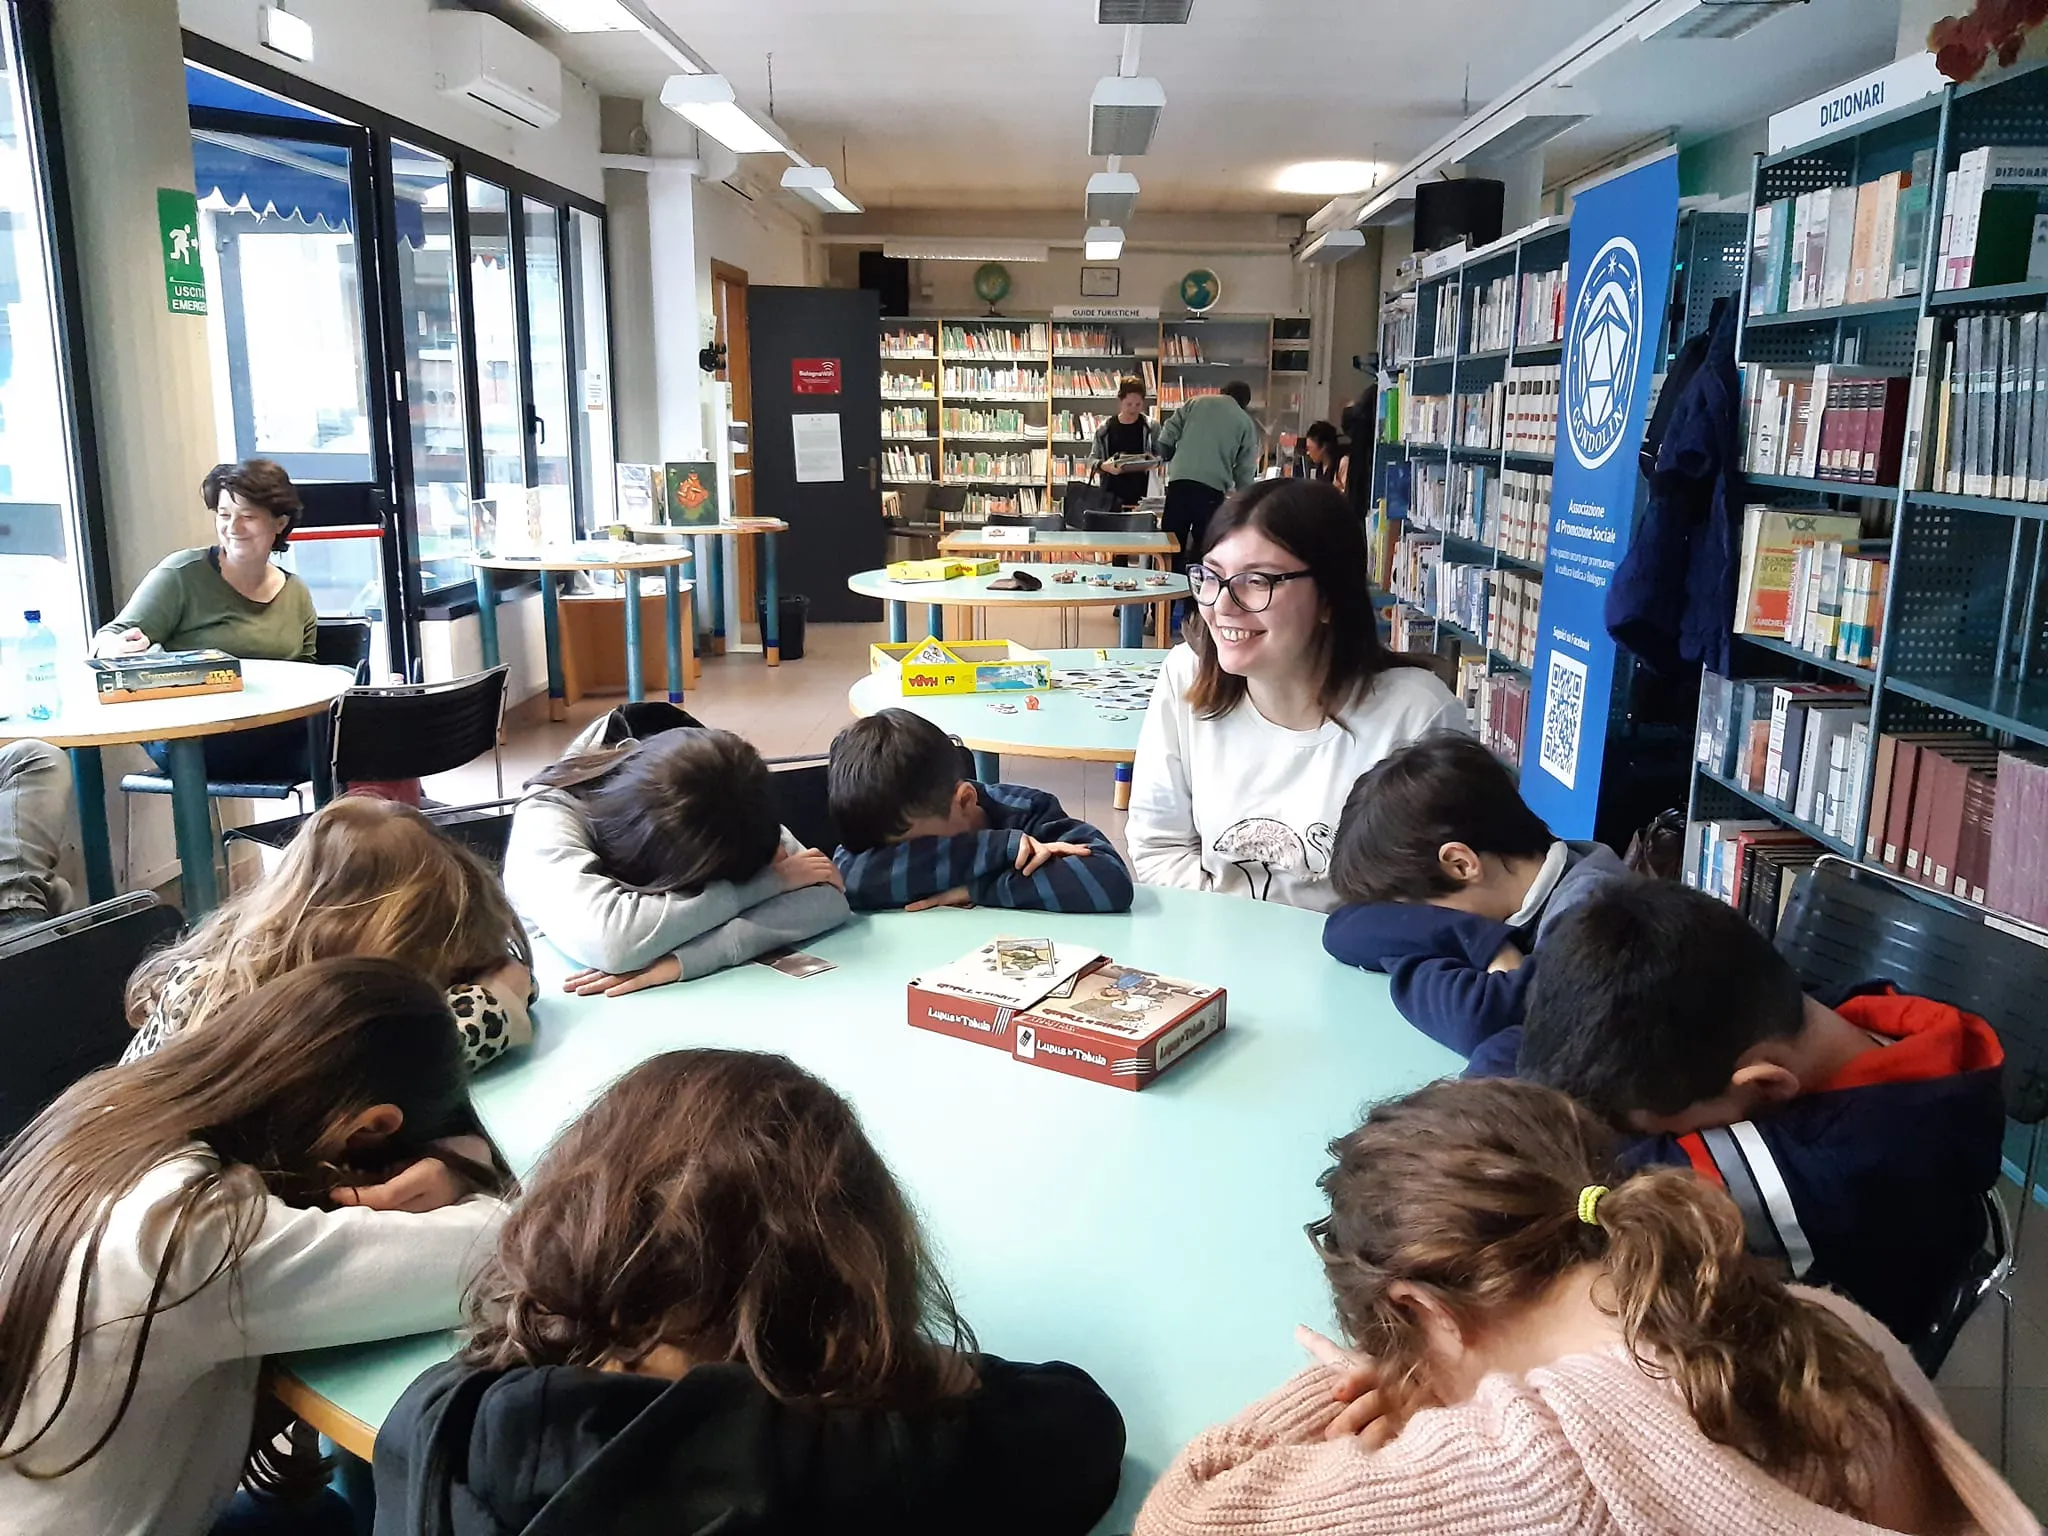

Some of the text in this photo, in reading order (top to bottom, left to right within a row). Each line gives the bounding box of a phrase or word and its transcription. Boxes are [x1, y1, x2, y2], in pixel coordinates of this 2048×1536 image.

[1820, 81, 1884, 128] DIZIONARI
[1072, 309, 1140, 317] GUIDE TURISTICHE
[1572, 402, 1624, 453] GONDOLIN
[1567, 498, 1606, 518] Associazione
[1561, 519, 1593, 540] Promozione
[1592, 525, 1616, 544] Sociale
[1785, 516, 1817, 532] VOX
[908, 673, 938, 688] HABA
[927, 1006, 955, 1023] Lupus
[960, 1015, 992, 1032] Tabula
[1036, 1039, 1067, 1056] Lupus
[1073, 1048, 1107, 1066] Tabula
